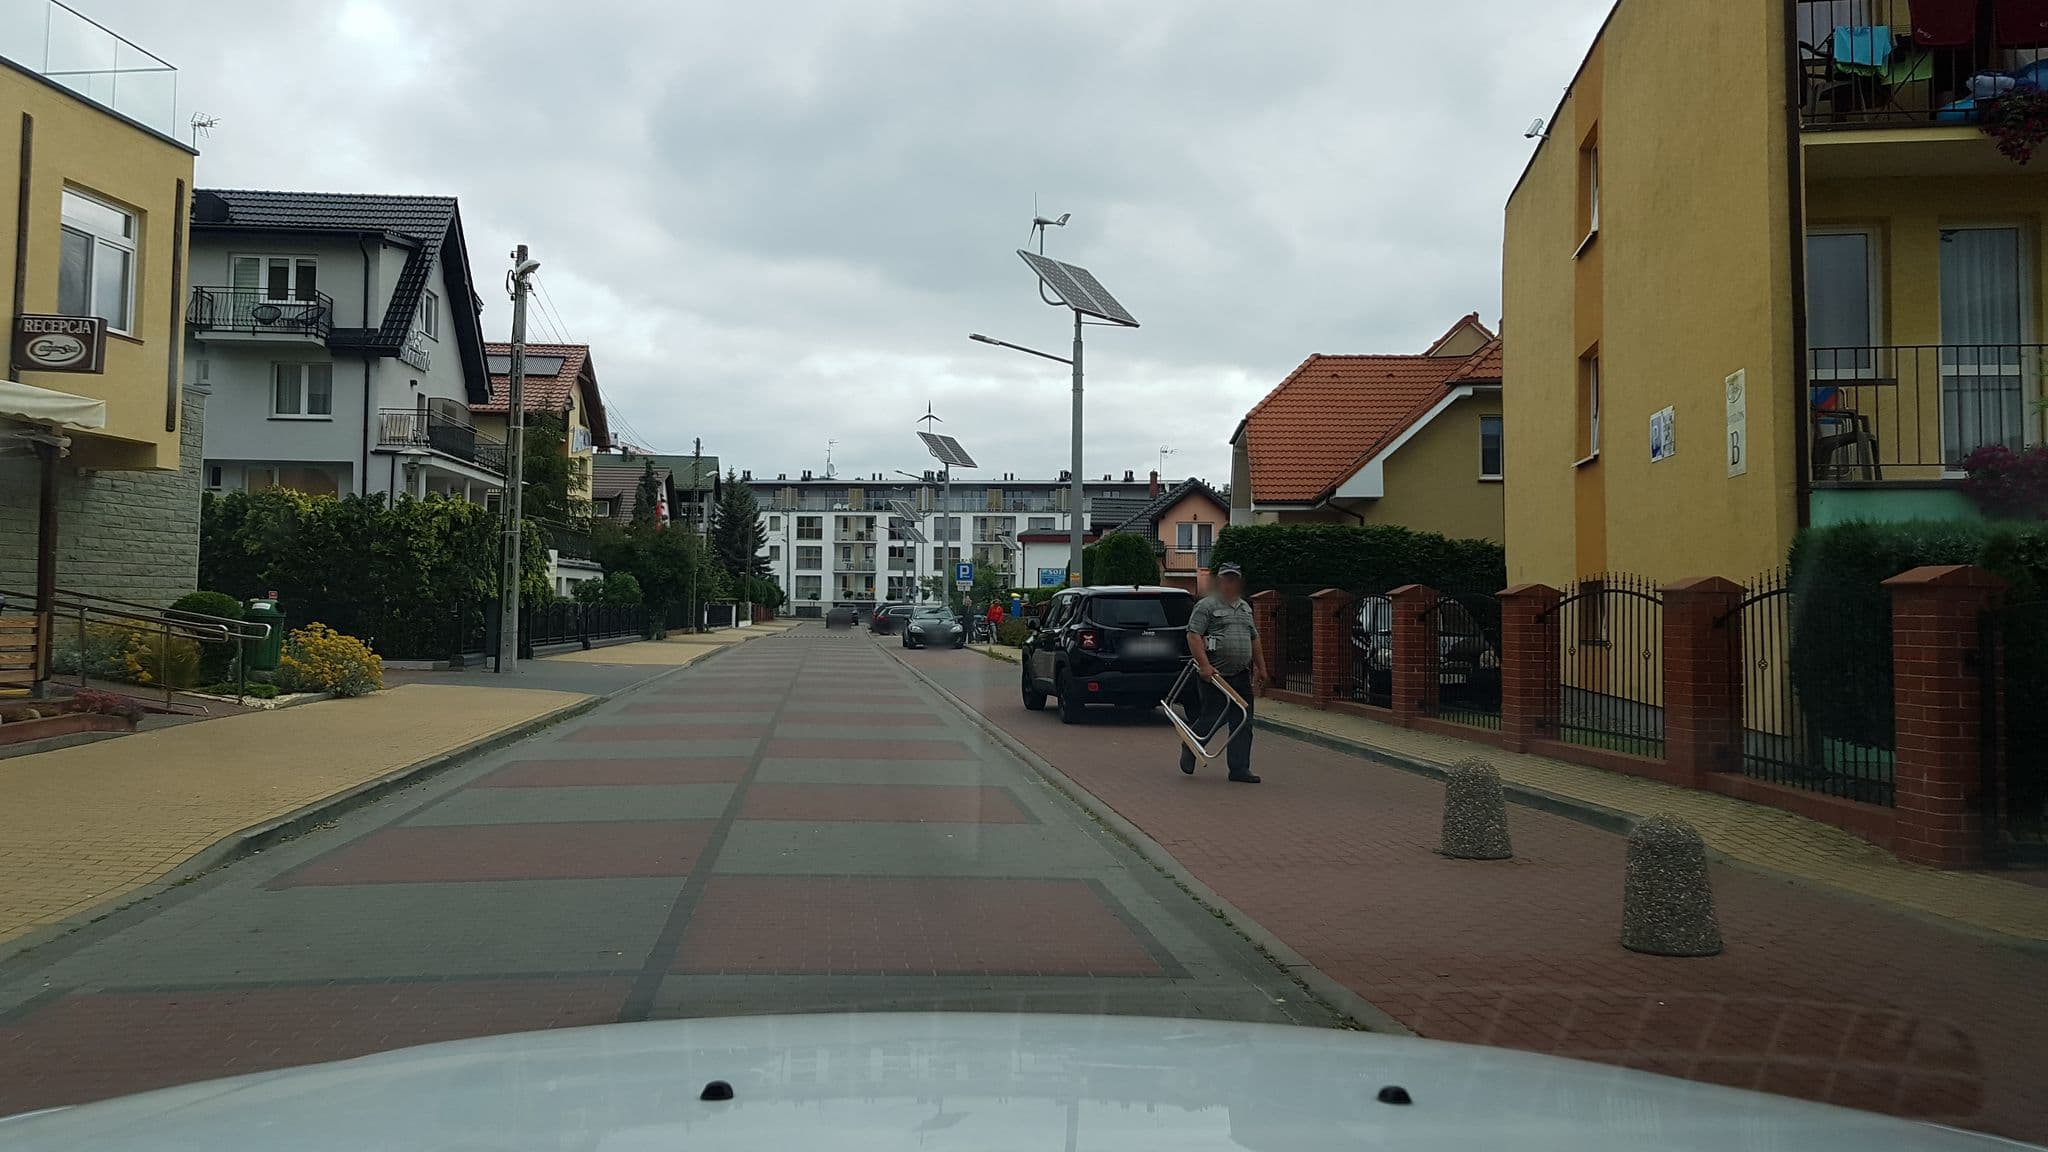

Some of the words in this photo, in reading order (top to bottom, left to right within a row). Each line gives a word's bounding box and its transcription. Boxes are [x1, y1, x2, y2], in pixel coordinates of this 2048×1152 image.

[23, 319, 92, 334] RECEPCJA
[1730, 431, 1740, 465] B
[960, 565, 970, 579] P
